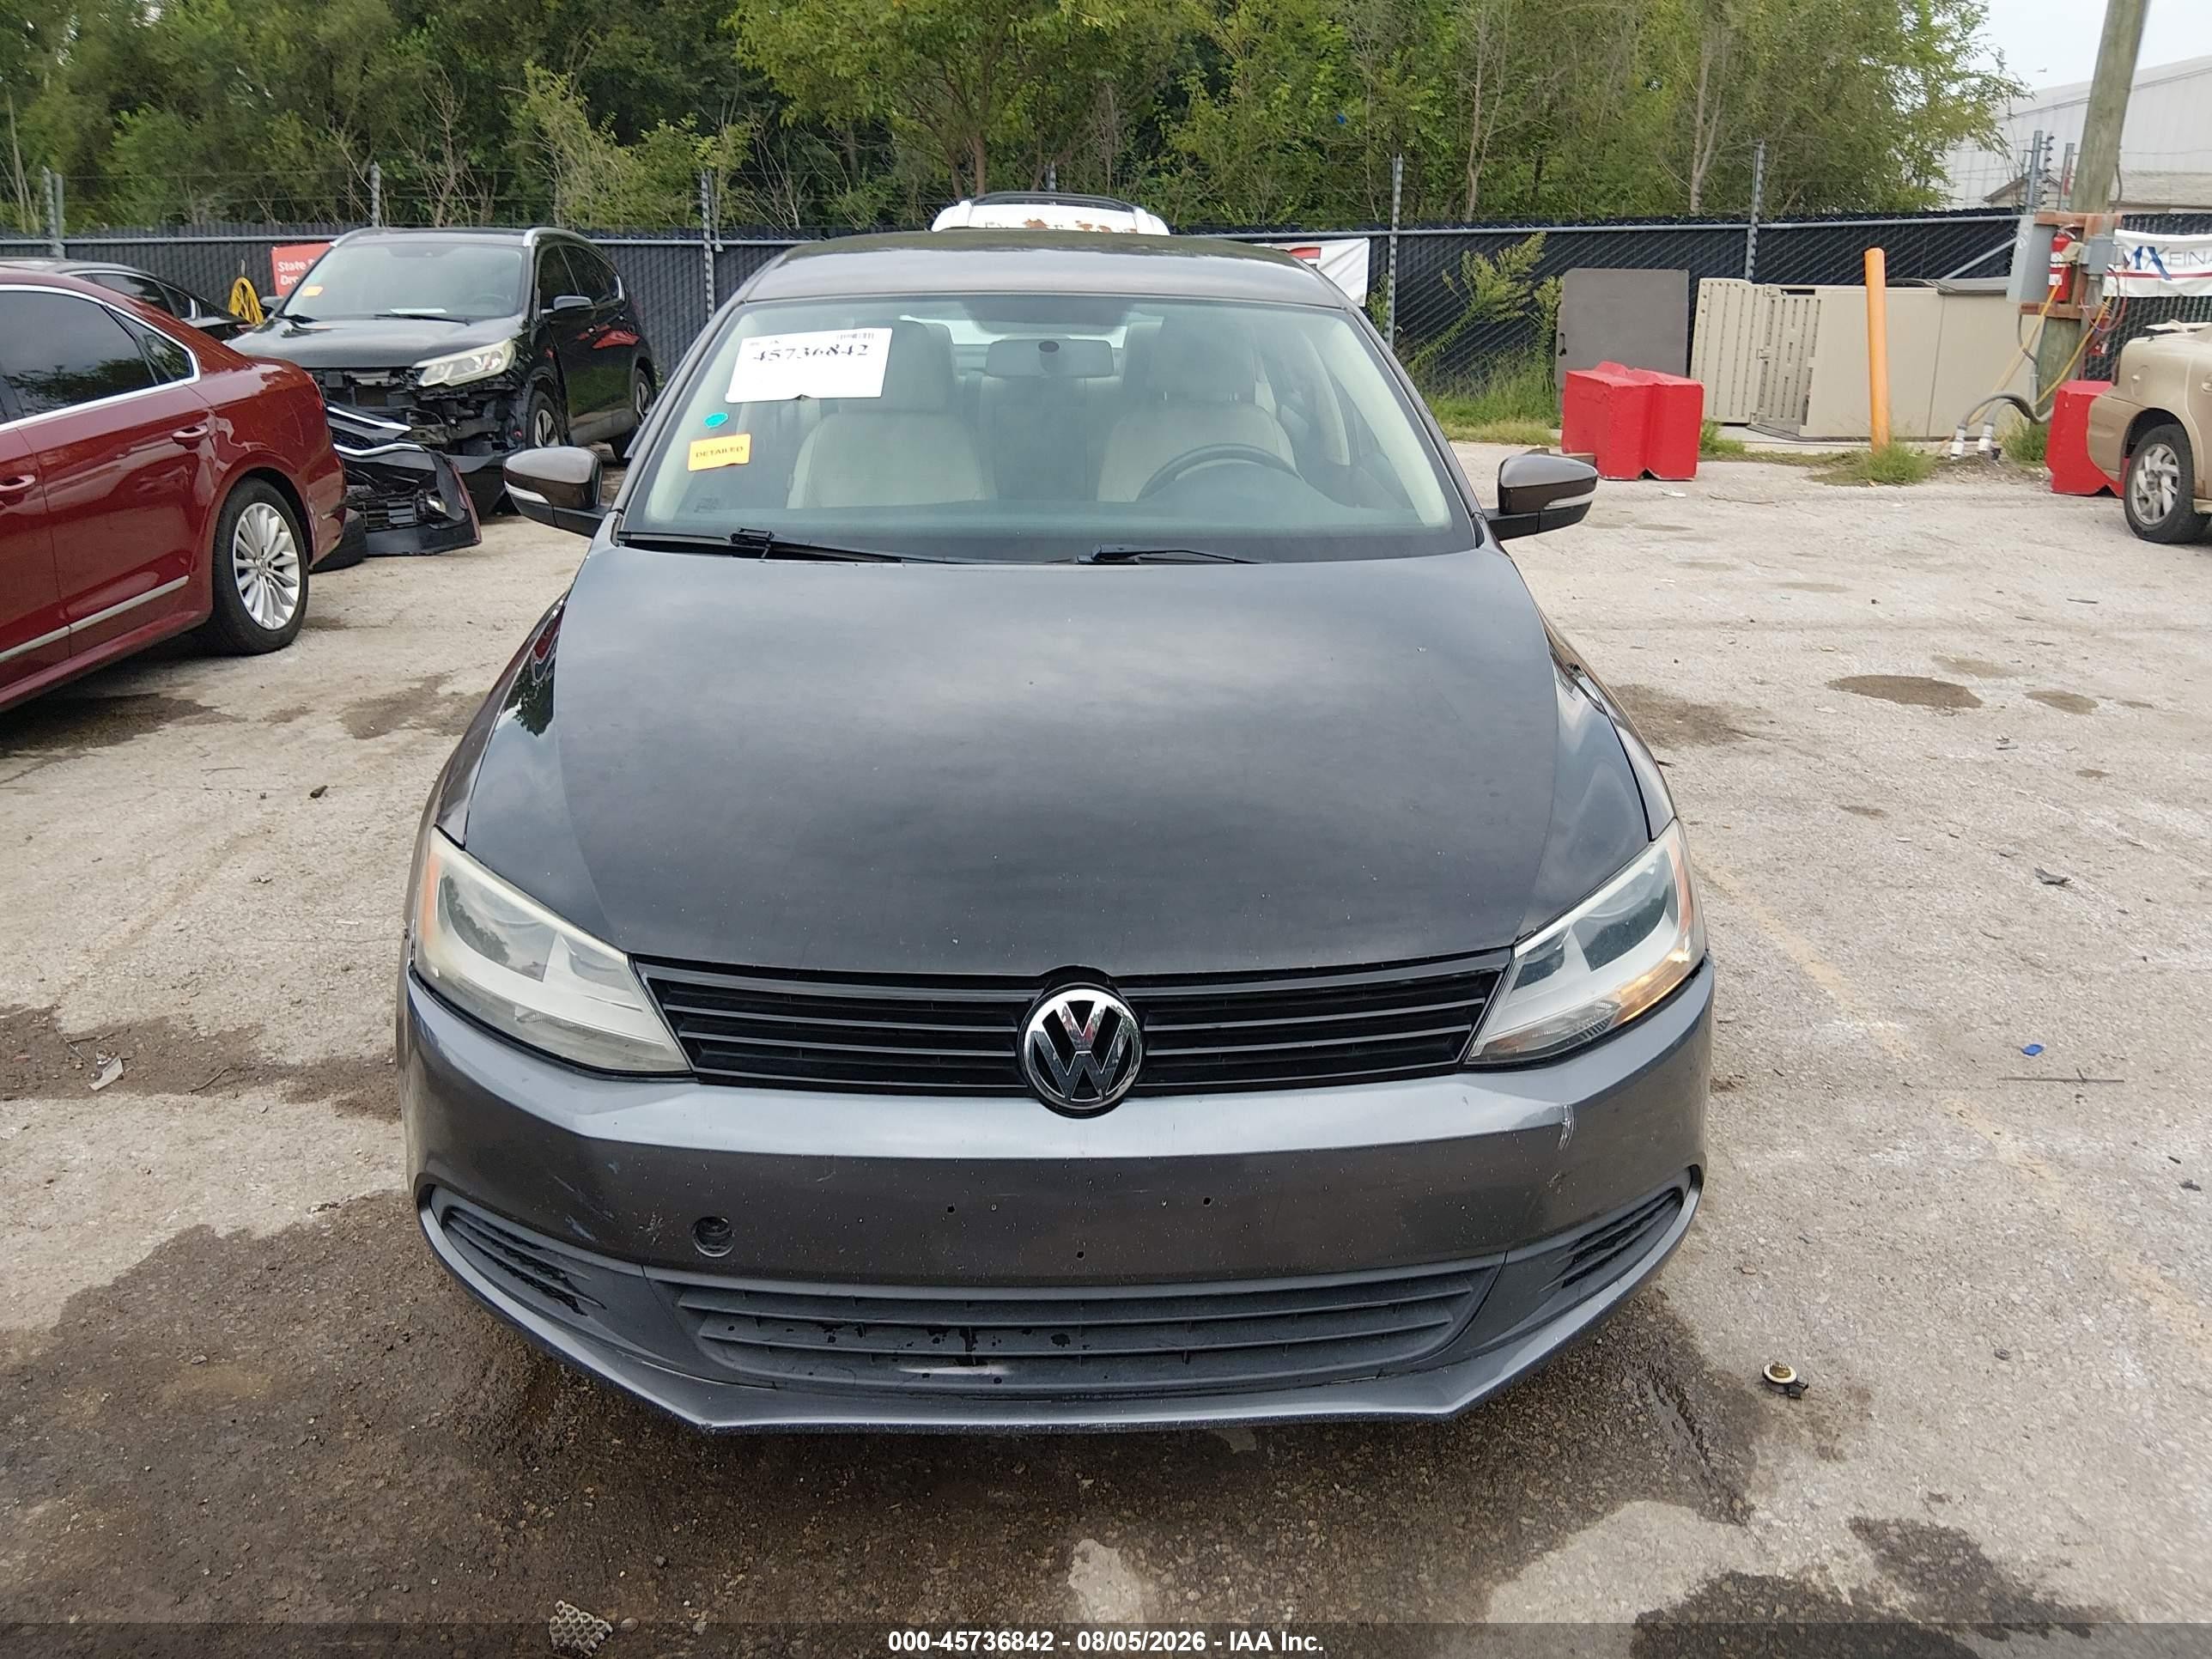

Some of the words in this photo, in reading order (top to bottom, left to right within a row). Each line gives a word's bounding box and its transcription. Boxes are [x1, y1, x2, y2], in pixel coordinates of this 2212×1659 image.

[2170, 251, 2212, 265] FIN
[277, 260, 307, 273] State
[752, 343, 870, 362] 45736842
[696, 446, 744, 459] DETAILED
[1024, 991, 1141, 1109] VW
